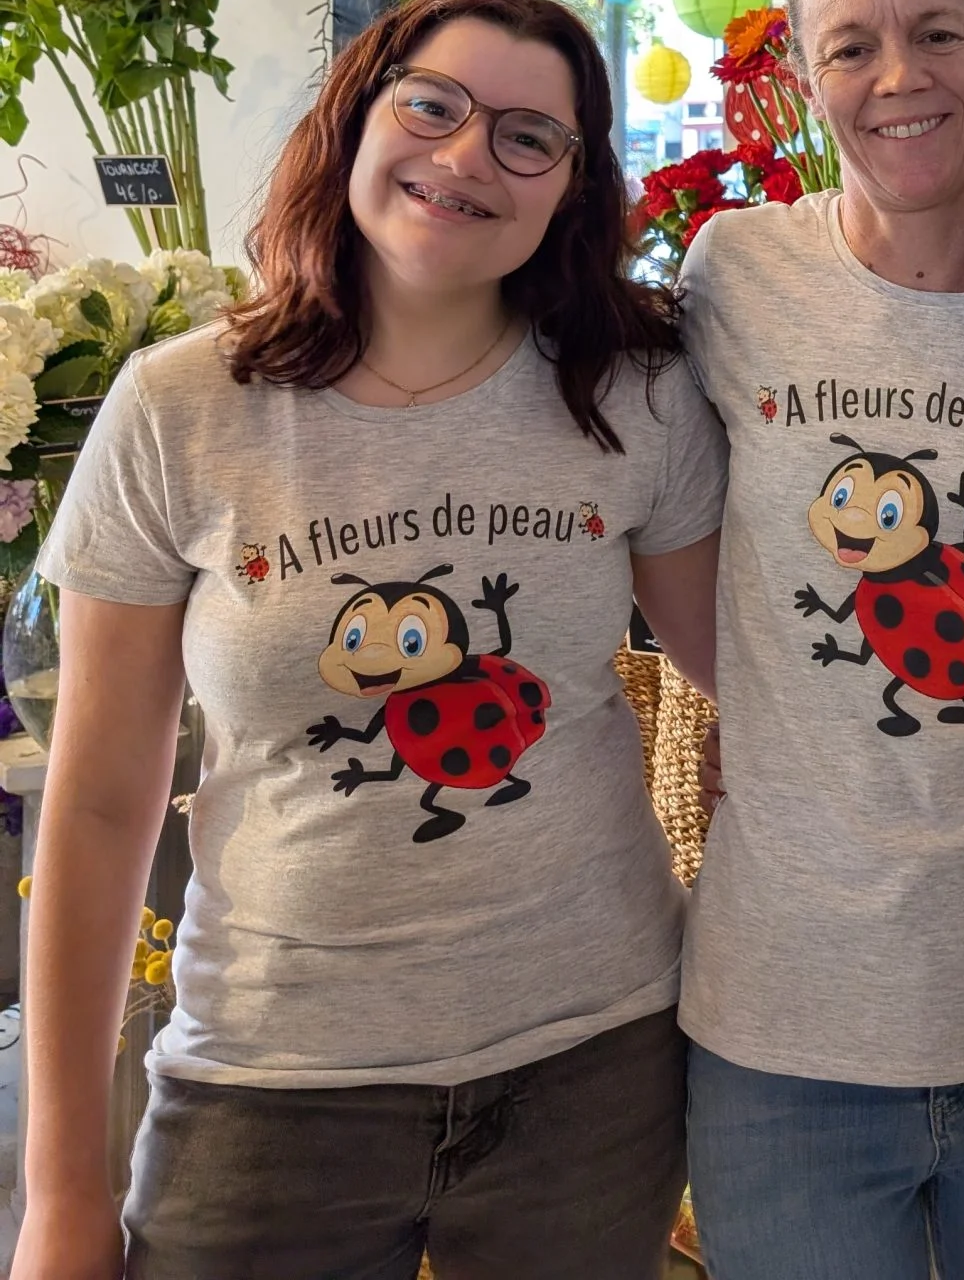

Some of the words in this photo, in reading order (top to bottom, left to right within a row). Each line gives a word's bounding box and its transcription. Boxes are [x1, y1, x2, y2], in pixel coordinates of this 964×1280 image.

[785, 383, 806, 427] A
[814, 379, 915, 421] fleurs
[277, 533, 304, 580] A
[308, 506, 421, 566] fleurs
[433, 492, 476, 538] de
[488, 502, 575, 545] peau
